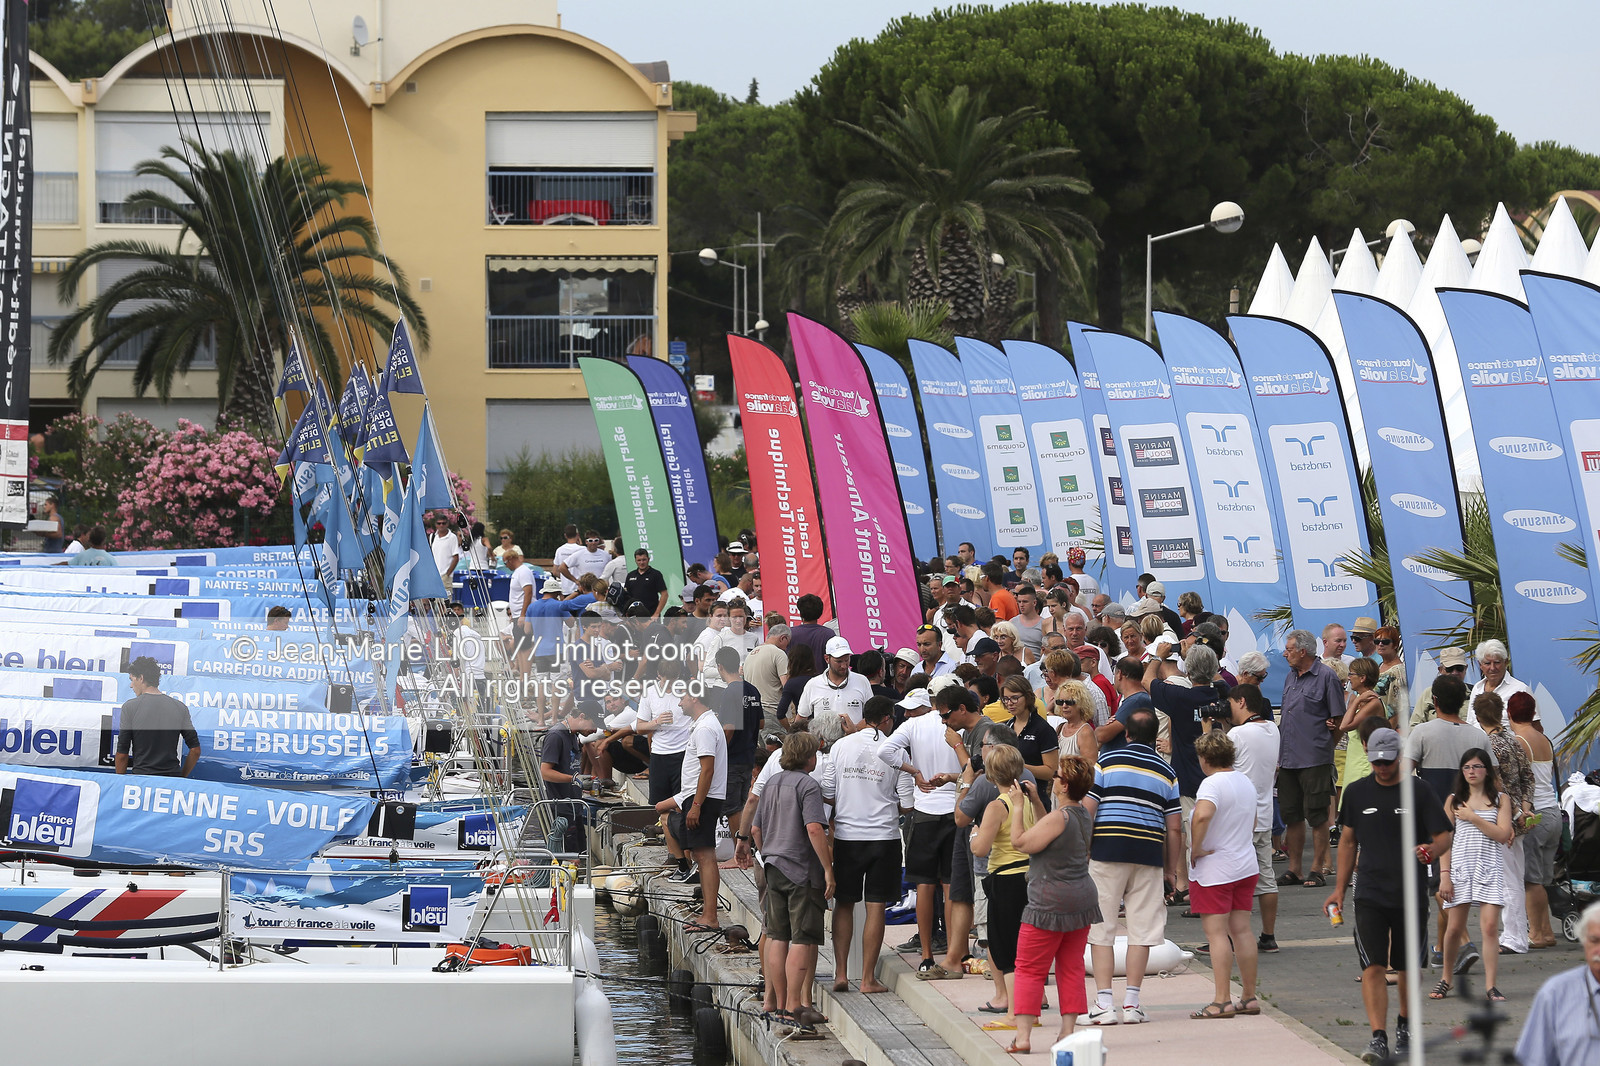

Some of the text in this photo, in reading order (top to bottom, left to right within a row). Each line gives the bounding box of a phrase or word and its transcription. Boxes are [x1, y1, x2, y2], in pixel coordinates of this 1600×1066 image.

[253, 551, 310, 562] BRETAGNE
[205, 580, 249, 591] NANTES
[257, 581, 290, 592] SAINT
[193, 660, 282, 680] CARREFOUR
[286, 667, 374, 684] ADDICTIONS
[217, 708, 386, 735] MARTINIQUE
[0, 718, 82, 756] bleu
[213, 730, 389, 757] BE.BRUSSELS
[121, 784, 239, 821] BIENNE
[38, 812, 74, 825] france
[10, 813, 73, 846] bleu
[465, 831, 496, 846] bleu
[203, 828, 265, 857] SRS
[413, 841, 436, 849] voile
[257, 917, 283, 928] tour
[296, 918, 333, 929] france
[349, 920, 376, 930] voile
[410, 908, 447, 925] bleu
